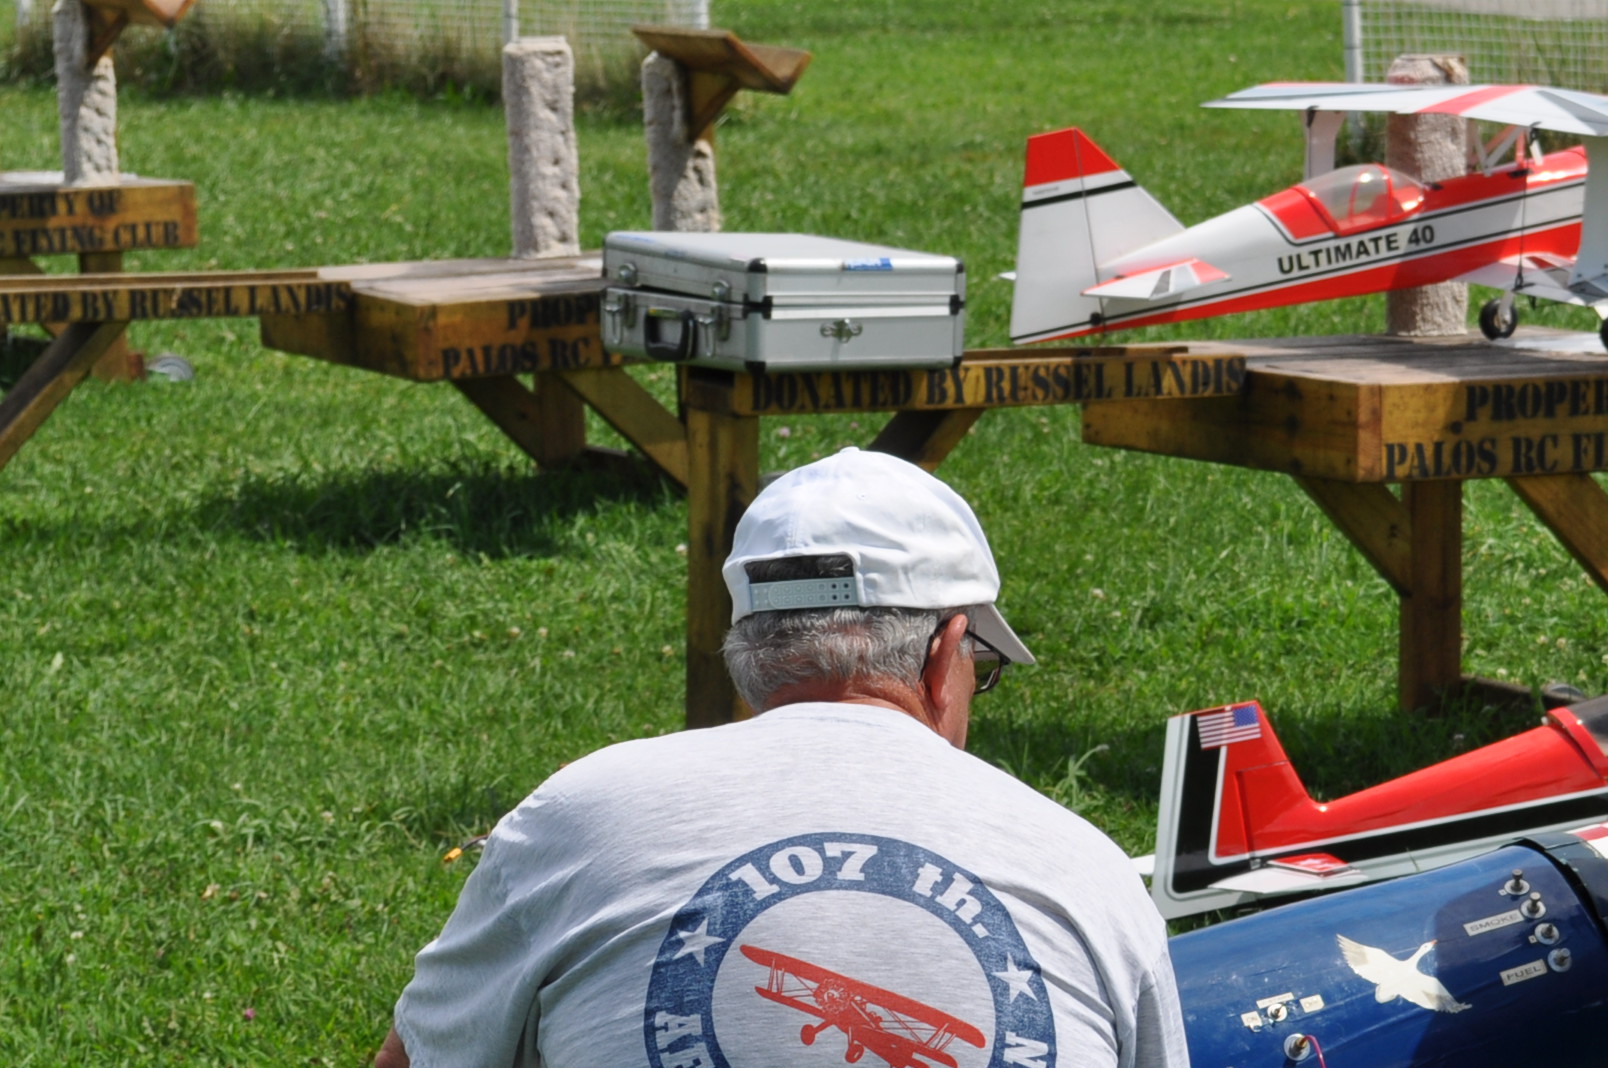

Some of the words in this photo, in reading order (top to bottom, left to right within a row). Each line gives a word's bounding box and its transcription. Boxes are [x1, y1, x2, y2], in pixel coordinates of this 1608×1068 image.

[12, 226, 104, 254] FLYING
[112, 221, 180, 249] CLUB
[1277, 232, 1400, 275] ULTIMATE
[1408, 225, 1434, 246] 40
[81, 290, 118, 321] BY
[129, 285, 240, 319] RUSSEL
[249, 281, 350, 315] LANDIS
[507, 293, 602, 331] PROP
[441, 339, 540, 379] PALOS
[547, 337, 593, 369] RC
[752, 371, 913, 411] DONATED
[926, 366, 970, 406] BY
[983, 361, 1113, 404] RUSSEL
[1124, 356, 1245, 399] LANDIS
[1385, 438, 1498, 481] PALOS
[1511, 434, 1559, 474] RC
[729, 842, 878, 900] 107
[913, 862, 992, 939] th.
[1469, 912, 1520, 933] SMOKE
[1505, 965, 1542, 982] FUEL
